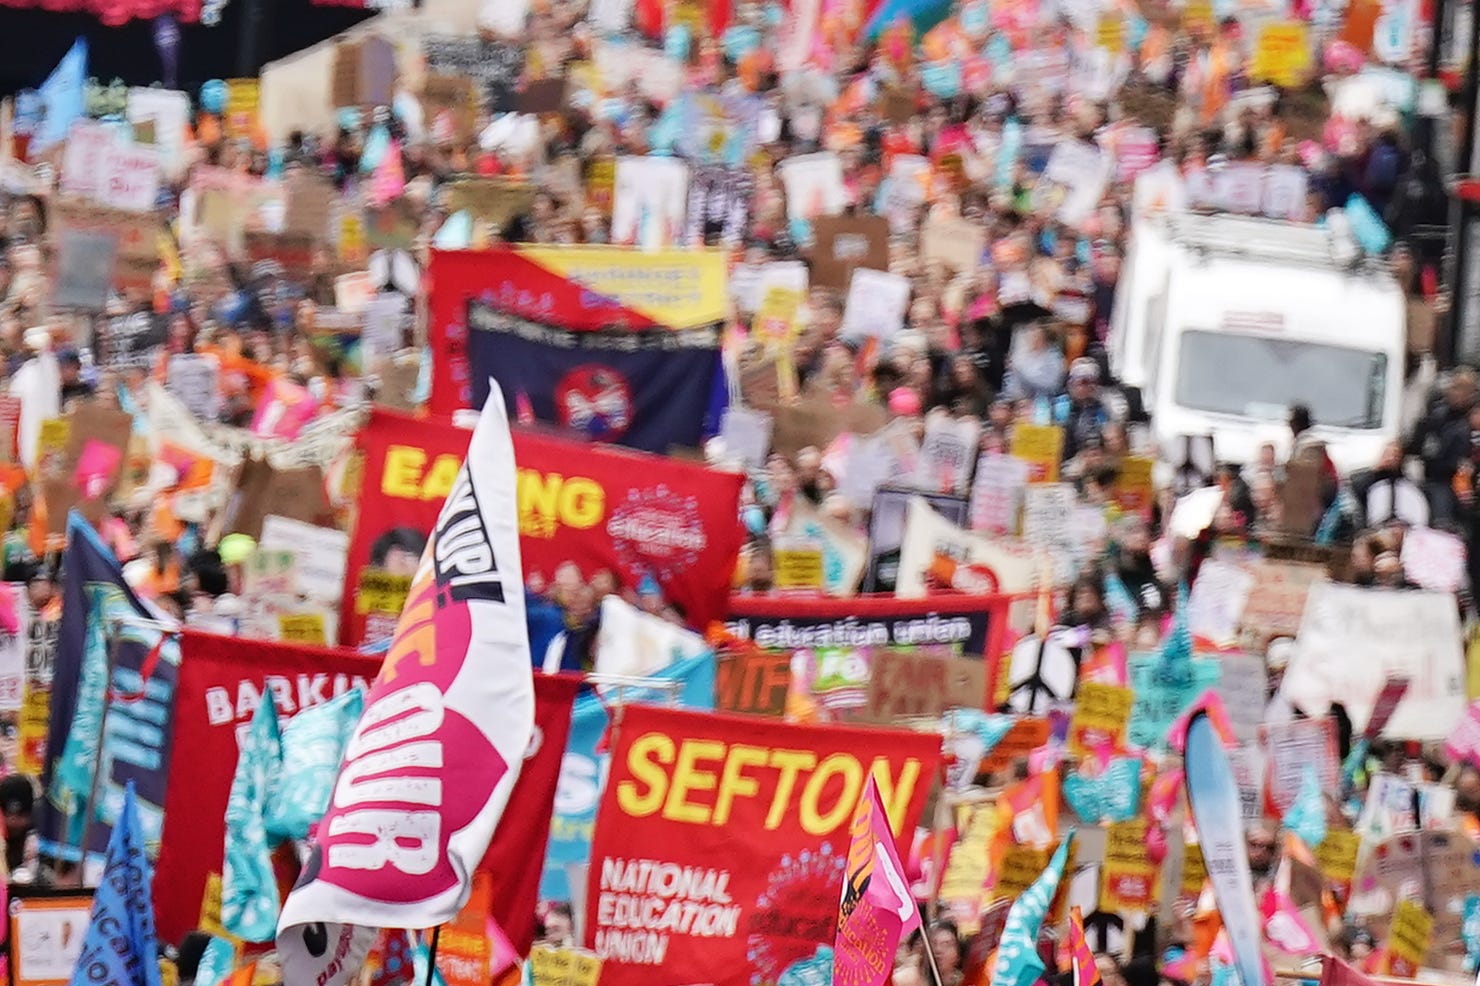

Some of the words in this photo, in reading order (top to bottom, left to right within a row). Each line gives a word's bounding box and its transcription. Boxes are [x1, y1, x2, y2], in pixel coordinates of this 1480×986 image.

[382, 445, 605, 529] EAING
[205, 672, 376, 726] BARKI
[617, 732, 922, 838] SEFTON
[600, 856, 732, 903] NATIONAL
[598, 892, 742, 938] EDUCATION
[594, 929, 669, 965] UNION
